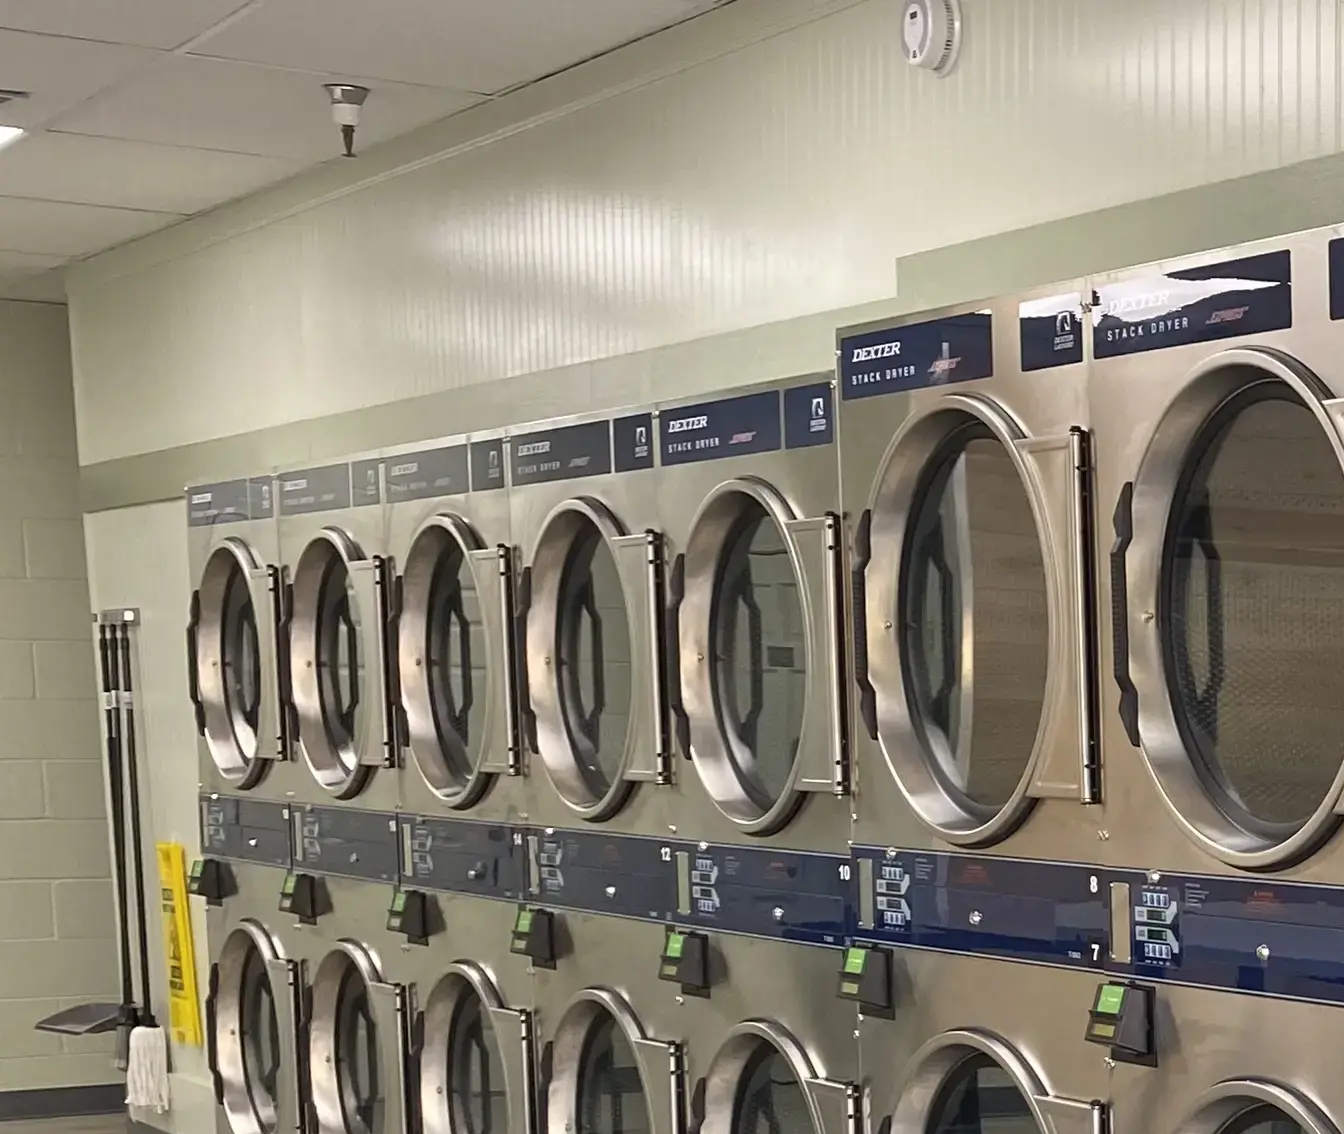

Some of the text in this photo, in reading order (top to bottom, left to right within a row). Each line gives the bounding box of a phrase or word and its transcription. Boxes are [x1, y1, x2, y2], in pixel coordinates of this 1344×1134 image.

[1108, 289, 1171, 315] DEXTER
[1107, 316, 1189, 341] STACK DRYER
[851, 341, 901, 363] DEXTER
[851, 371, 882, 386] STACK
[885, 365, 916, 380] DRYER
[667, 415, 708, 434] DEXTER
[838, 864, 851, 881] 10
[1089, 875, 1098, 893] 8
[1091, 943, 1100, 961] 7
